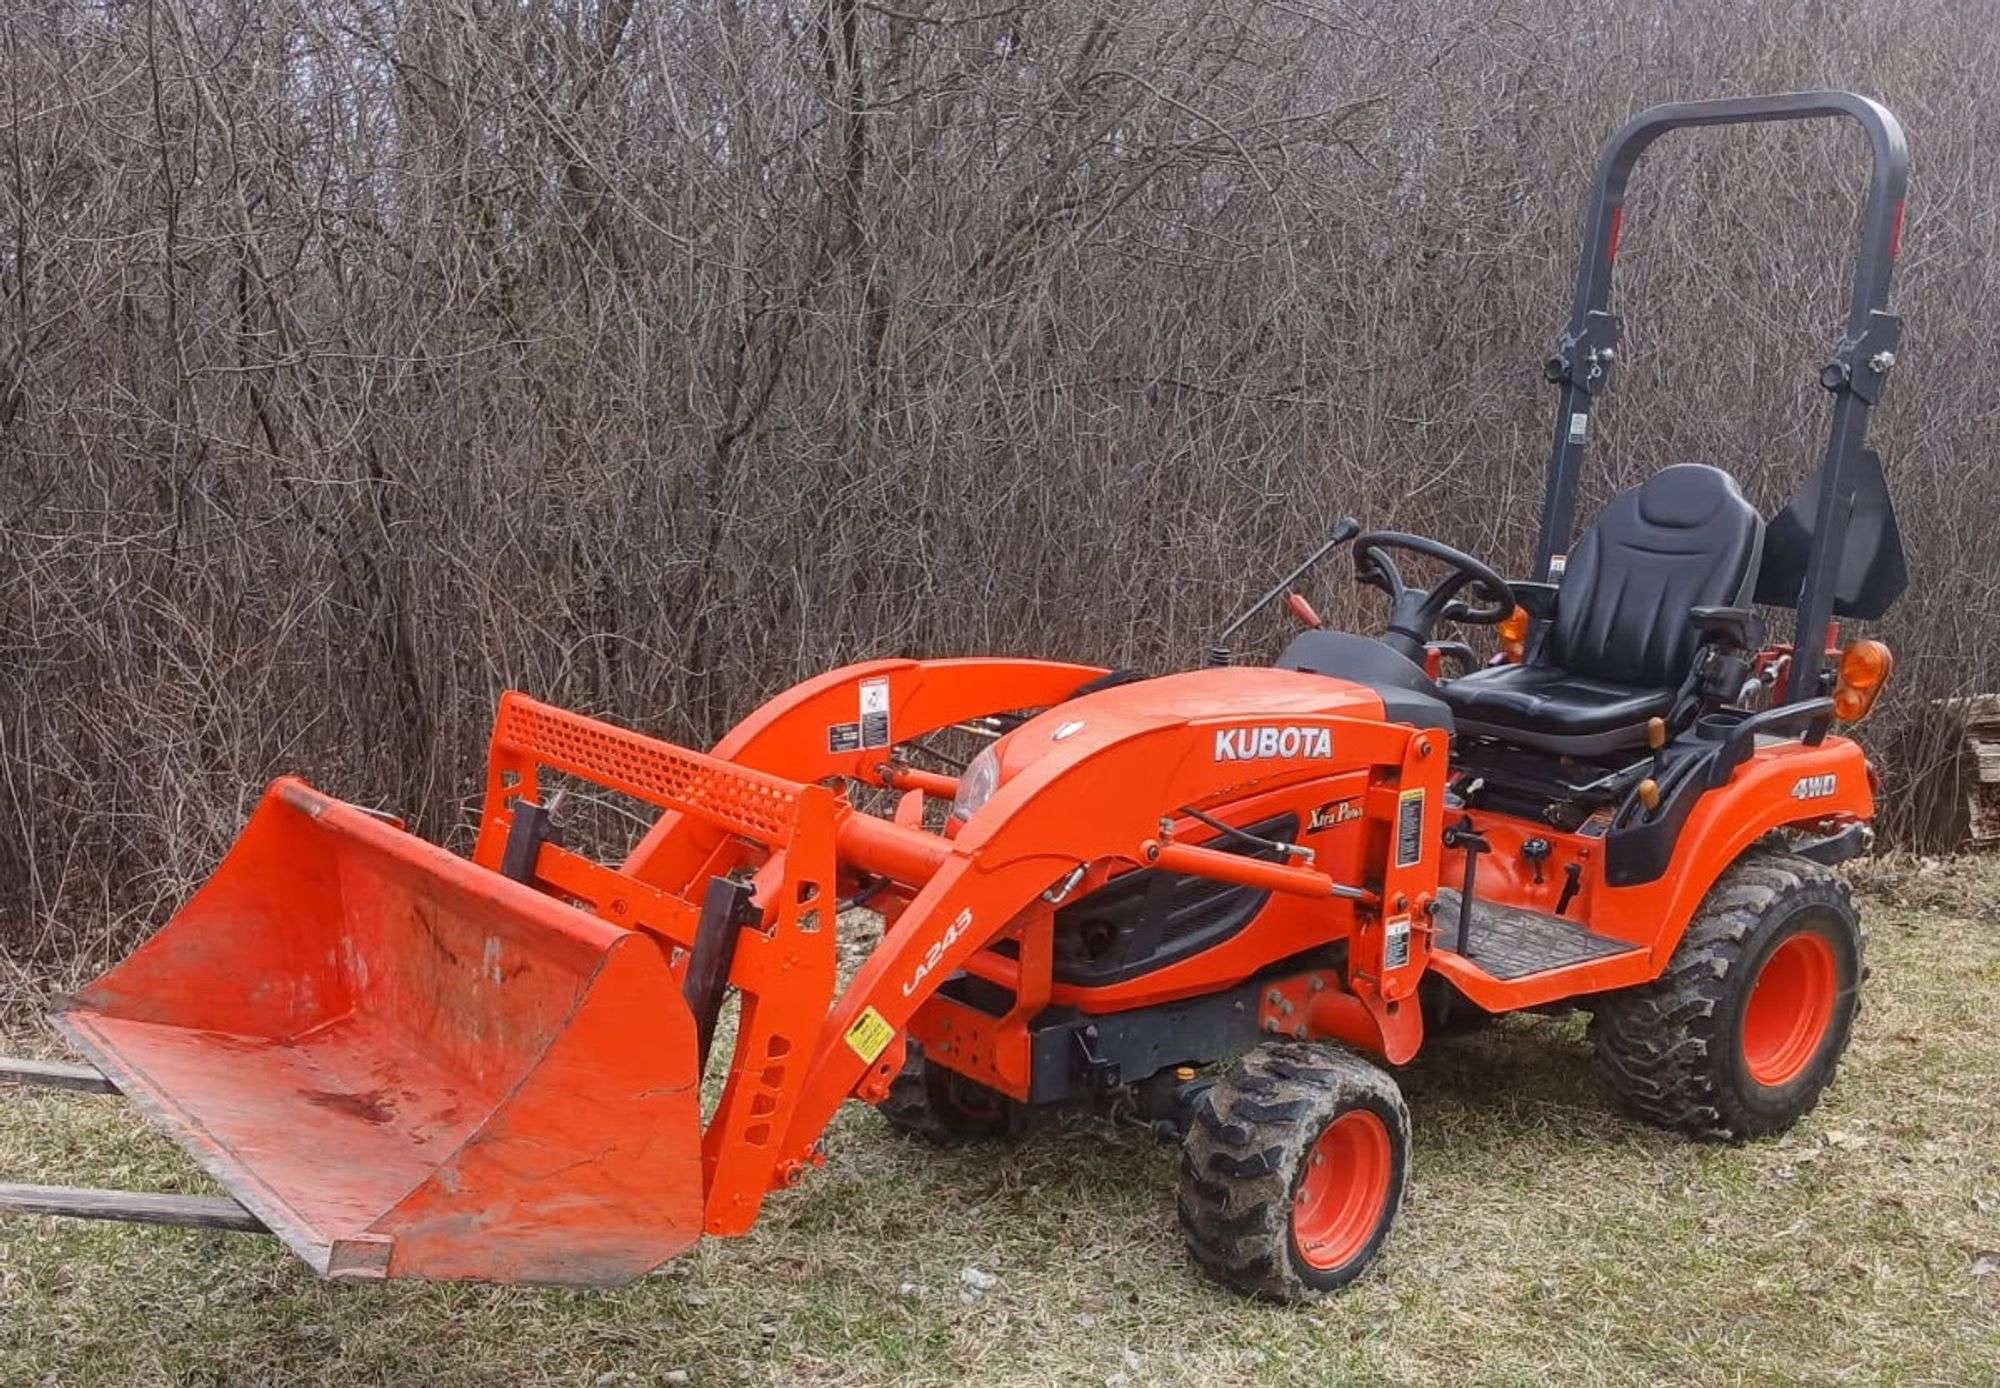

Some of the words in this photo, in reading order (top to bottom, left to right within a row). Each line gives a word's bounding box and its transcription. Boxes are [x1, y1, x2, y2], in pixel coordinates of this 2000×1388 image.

[1214, 726, 1333, 762] KUBOTA
[1791, 773, 1837, 800] 4WD
[1306, 806, 1335, 829] Xtra
[903, 907, 972, 996] LA243
